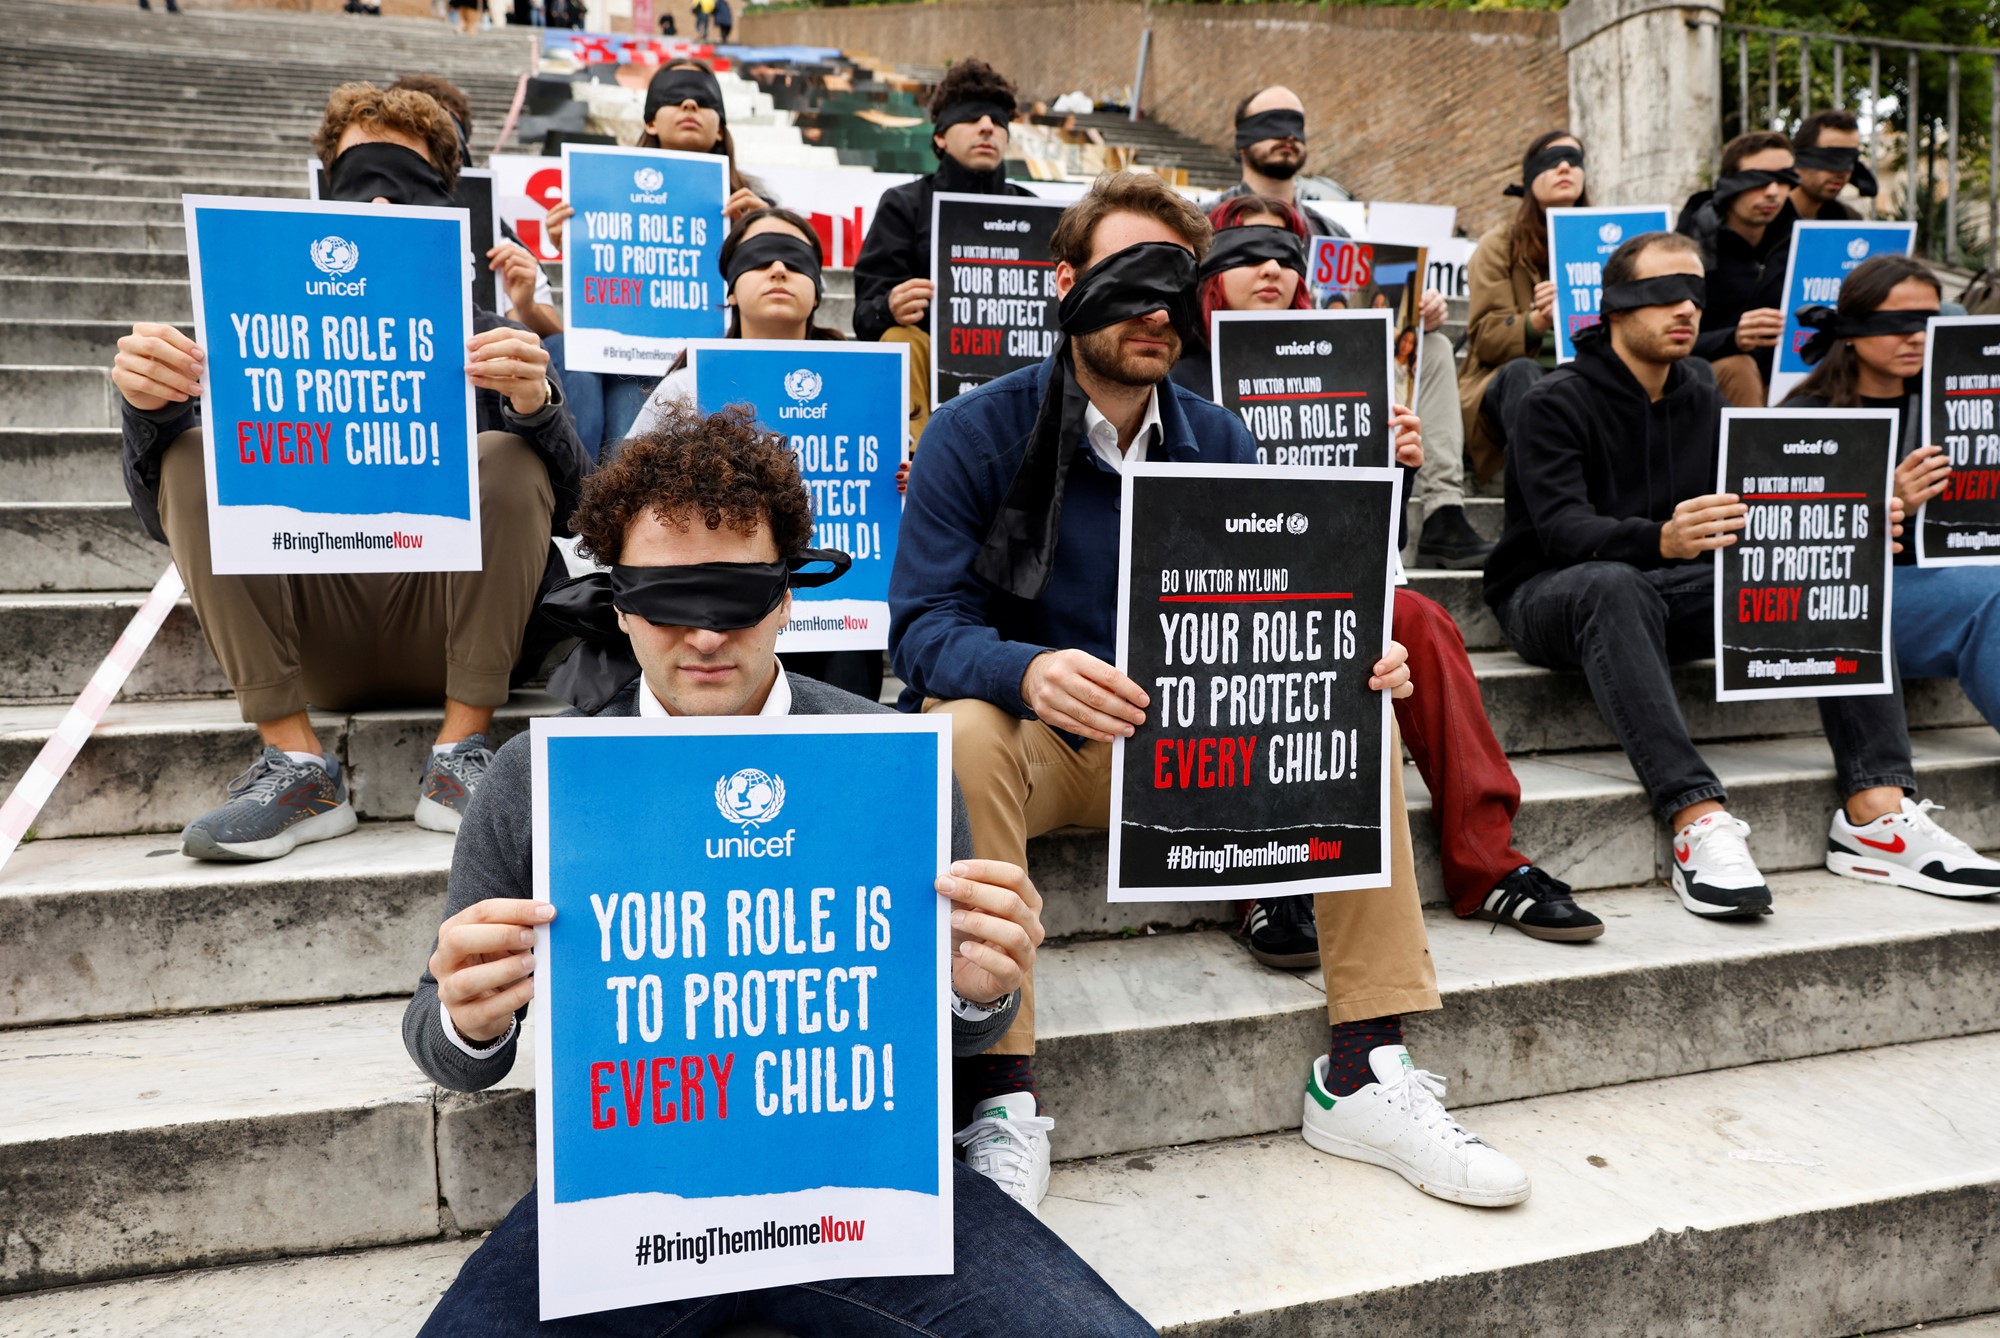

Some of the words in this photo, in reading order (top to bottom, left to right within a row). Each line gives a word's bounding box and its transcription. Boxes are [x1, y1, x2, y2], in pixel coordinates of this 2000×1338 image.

[630, 191, 668, 204] unicef
[584, 211, 632, 241] YOUR
[638, 213, 684, 244] ROLE
[690, 216, 707, 246] IS
[590, 243, 615, 273] TO
[622, 245, 701, 277] PROTECT
[1316, 242, 1374, 286] SOS
[1565, 262, 1602, 286] YOUR
[306, 277, 367, 297] unicef
[584, 276, 643, 306] EVERY
[650, 279, 708, 311] CHILD!
[950, 266, 992, 295] YOUR
[998, 268, 1039, 297] ROLE
[1802, 277, 1841, 301] YOUR
[950, 297, 971, 325] TO
[977, 299, 1047, 327] PROTECT
[1571, 288, 1591, 312] TO
[230, 313, 310, 360] YOUR
[321, 315, 396, 362] ROLE
[409, 317, 434, 363] IS
[603, 346, 684, 362] #BringThemHome
[950, 328, 1003, 356] EVERY
[1276, 341, 1315, 356] unicef
[244, 367, 283, 413] TO
[296, 369, 426, 413] PROTECT
[1238, 379, 1251, 396] BO
[1253, 378, 1285, 395] VIKTOR
[1286, 376, 1322, 393] NYLUND
[779, 403, 827, 419] unicef
[1240, 405, 1293, 441] YOUR
[1300, 403, 1348, 439] ROLE
[1354, 402, 1371, 437] IS
[1945, 399, 1993, 431] YOUR
[238, 421, 333, 465] EVERY
[345, 422, 441, 466] CHILD!
[858, 434, 879, 473] IS
[1783, 439, 1822, 454] unicef
[1945, 434, 1969, 466] TO
[1225, 512, 1284, 534] unicef
[1743, 505, 1793, 541] YOUR
[1800, 504, 1846, 540] ROLE
[1852, 504, 1869, 539] IS
[272, 531, 424, 554] #BringThemHomeNow
[1739, 546, 1765, 582] TO
[1771, 545, 1855, 581] PROTECT
[1161, 569, 1179, 593] BO
[1185, 569, 1233, 594] VIKTOR
[1238, 568, 1289, 592] NYLUND
[1738, 587, 1803, 623] EVERY
[1808, 584, 1869, 621] CHILD!
[1159, 612, 1239, 666] YOUR
[1253, 610, 1322, 664] ROLE
[1334, 609, 1357, 660] IS
[1747, 657, 1858, 680] #BringThemHomeNow
[1156, 675, 1195, 728] TO
[1210, 671, 1337, 726] PROTECT
[1153, 735, 1257, 789] EVERY
[1268, 729, 1357, 785] CHILD!
[706, 829, 795, 859] unicef
[1167, 837, 1342, 874] #BringThemHomeNow
[590, 889, 705, 962] YOUR
[726, 887, 835, 956] ROLE
[856, 885, 892, 953] IS
[606, 973, 663, 1044] TO
[684, 966, 877, 1040] PROTECT
[590, 1052, 736, 1131] EVERY
[755, 1043, 895, 1117] CHILD!
[635, 1214, 865, 1265] #BringThemHomeNow
